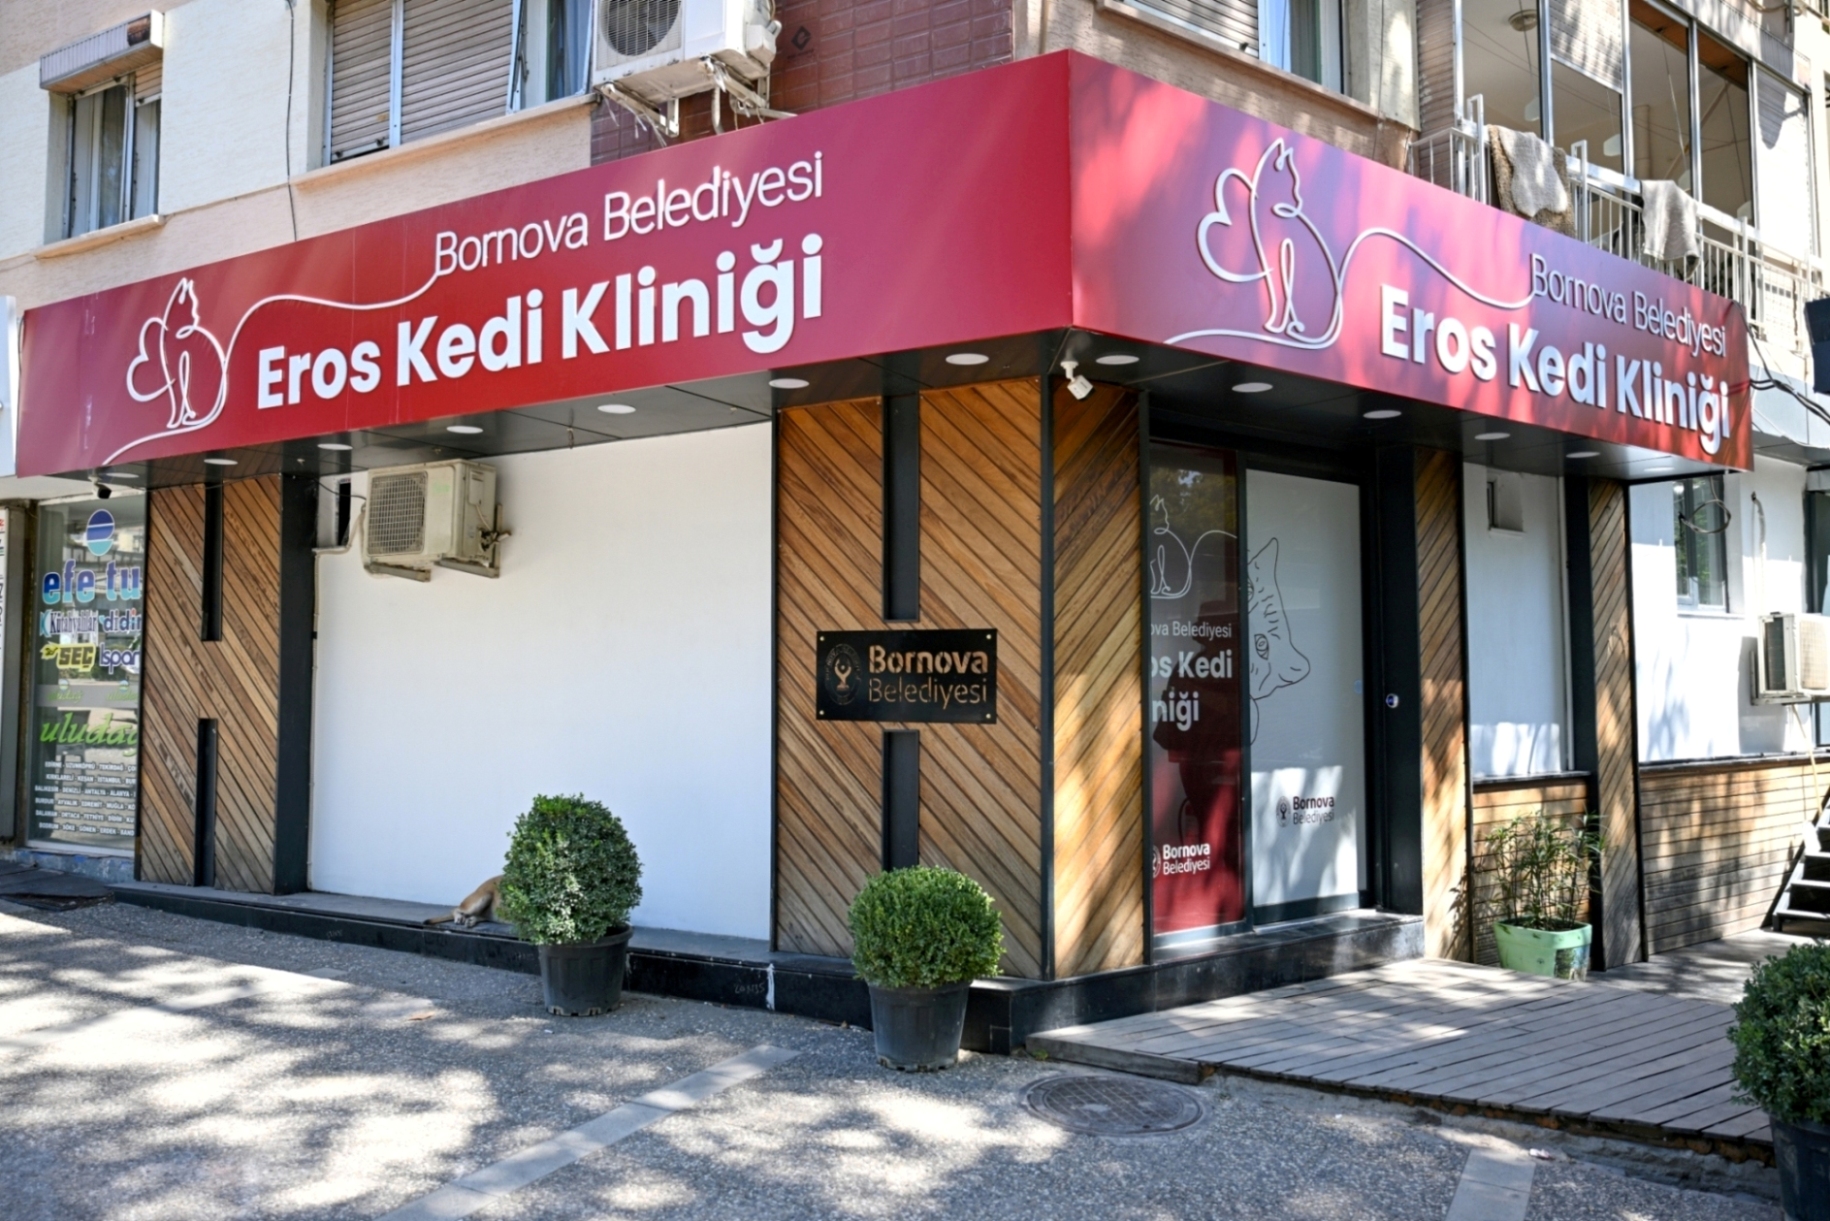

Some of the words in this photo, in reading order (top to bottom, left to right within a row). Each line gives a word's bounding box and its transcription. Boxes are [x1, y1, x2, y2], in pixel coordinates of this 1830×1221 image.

[434, 211, 590, 277] Bornova
[603, 151, 824, 241] Belediyesi
[256, 340, 382, 410] Eros
[396, 288, 544, 387] Kedi
[561, 233, 824, 359] Kliniği
[1529, 252, 1628, 325] Bornova
[1631, 289, 1727, 360] Belediyesi
[1380, 283, 1498, 382] Eros
[1507, 322, 1608, 410] Kedi
[1615, 354, 1731, 456] Kliniği
[42, 558, 95, 605] efe
[1172, 620, 1232, 641] Belediyesi
[58, 645, 95, 670] SEÇ
[868, 644, 989, 675] Bornova
[1178, 648, 1233, 679] Kedi
[868, 676, 988, 711] Belediyesi
[1152, 690, 1200, 732] niği
[1292, 796, 1335, 811] Bornova
[1292, 809, 1335, 825] Belediyesi
[1162, 842, 1211, 860] Bornova
[1162, 857, 1211, 875] Belediyesi
